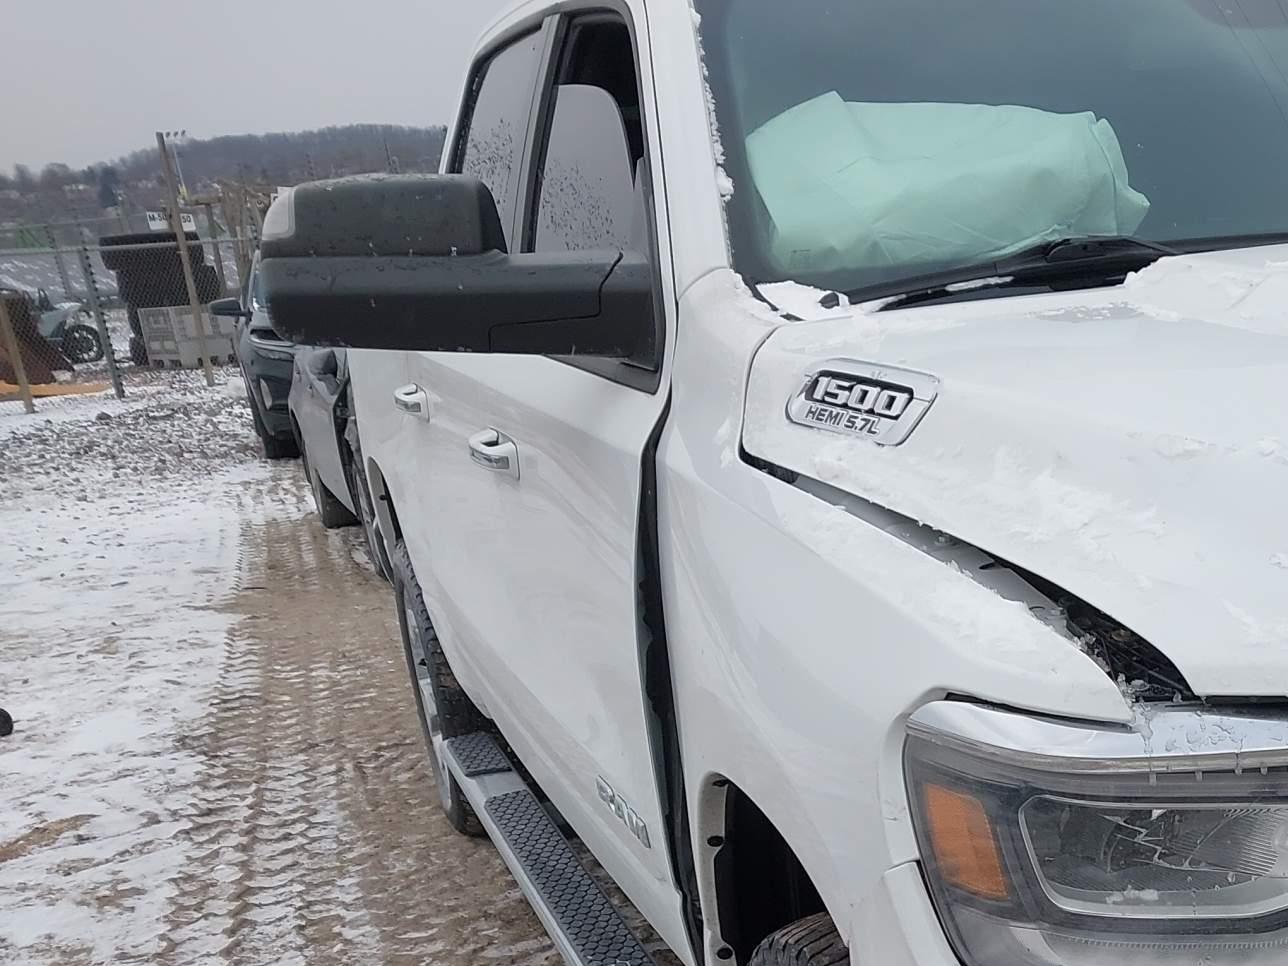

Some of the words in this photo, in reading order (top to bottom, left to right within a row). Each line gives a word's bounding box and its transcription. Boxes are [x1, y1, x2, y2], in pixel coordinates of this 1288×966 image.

[812, 375, 911, 417] 1500
[805, 406, 843, 426] HEMI
[844, 413, 880, 435] 5.7L
[596, 774, 652, 849] RAM
